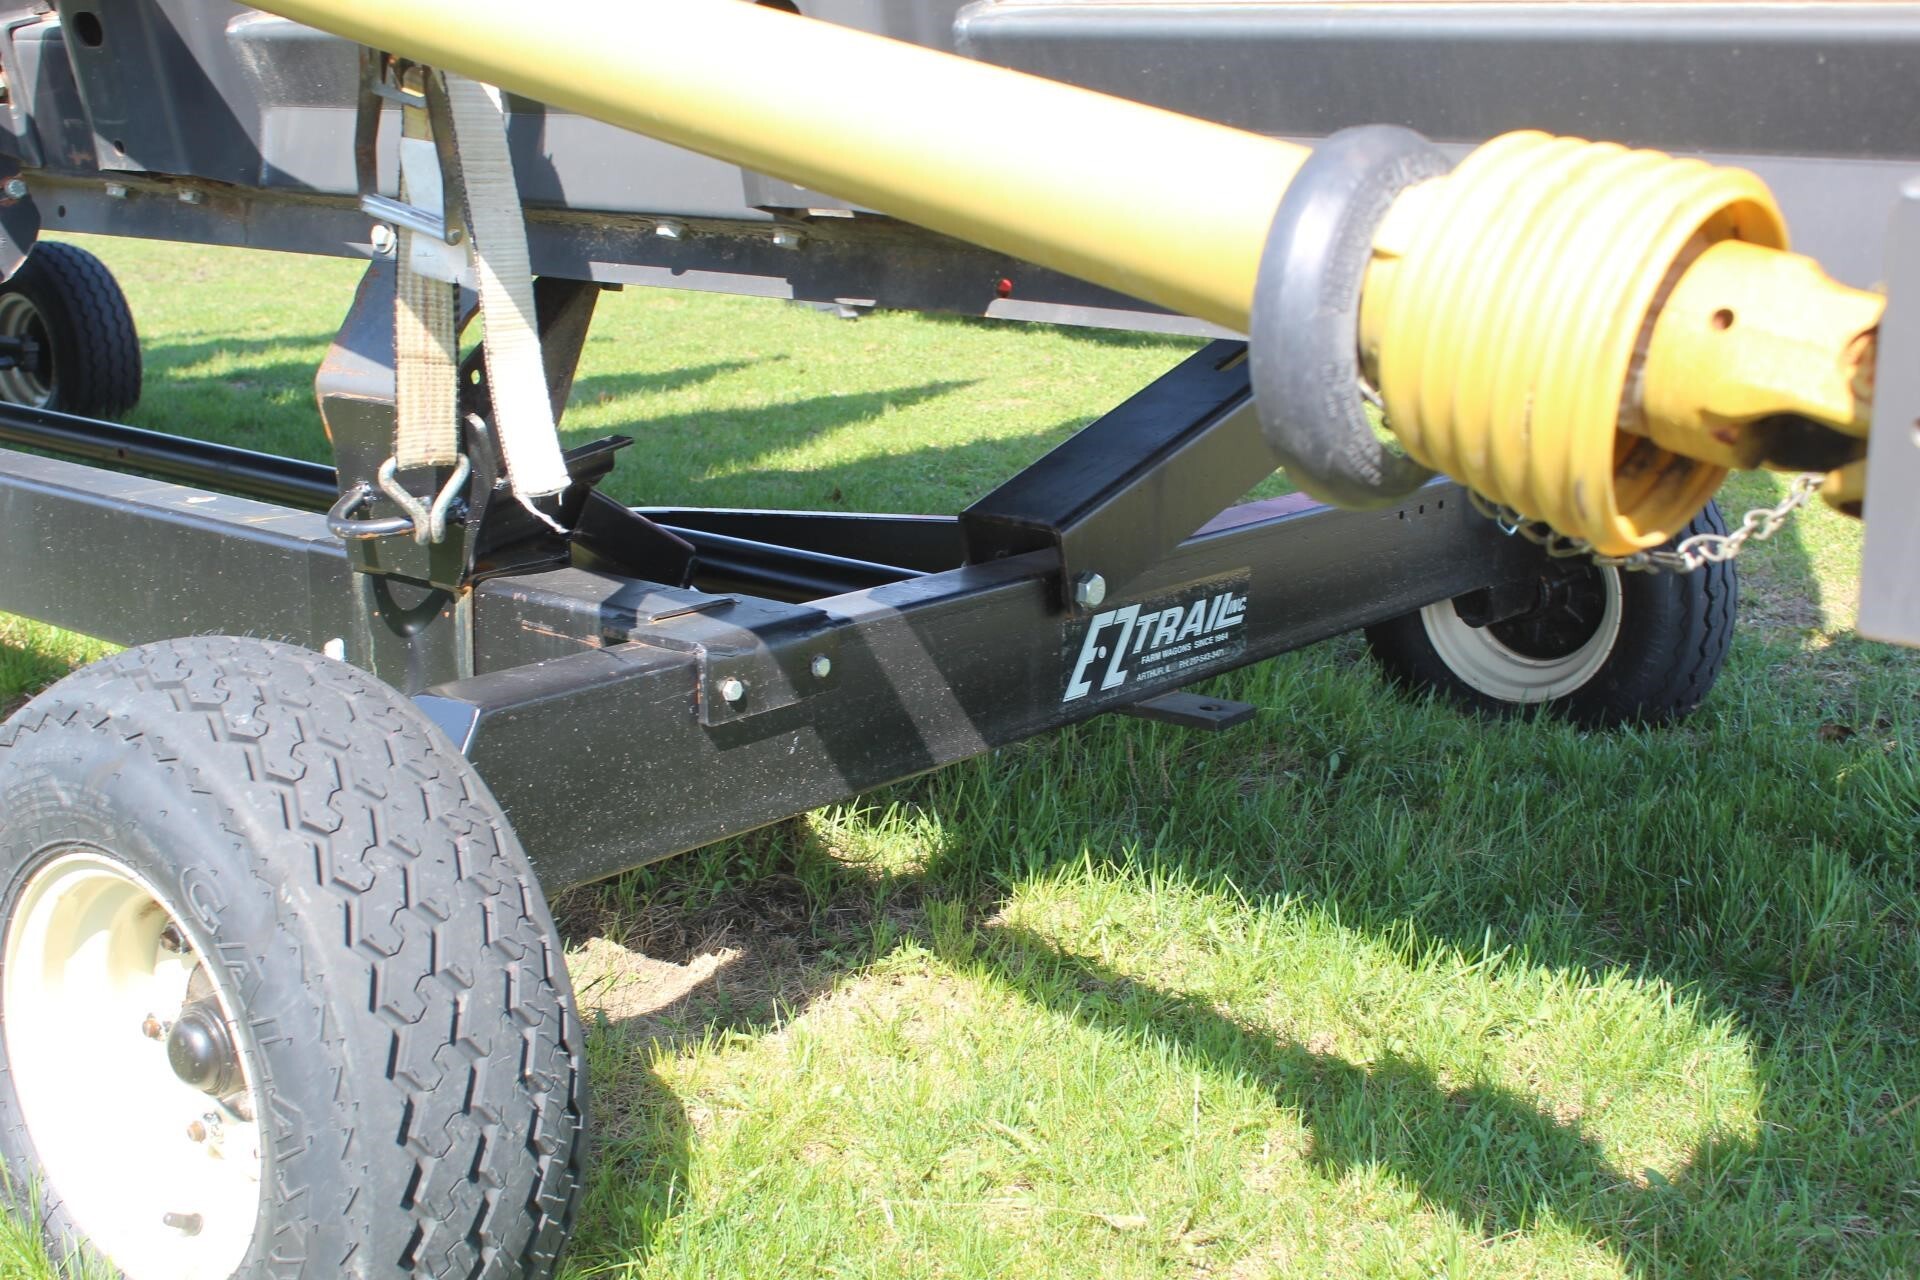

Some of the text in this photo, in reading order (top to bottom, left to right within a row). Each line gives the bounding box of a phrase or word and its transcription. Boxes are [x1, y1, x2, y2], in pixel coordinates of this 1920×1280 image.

[1132, 592, 1244, 654] TRAIL
[1141, 652, 1161, 665] FARM
[1162, 642, 1191, 658] WAGONS
[1193, 635, 1214, 649] SINCE
